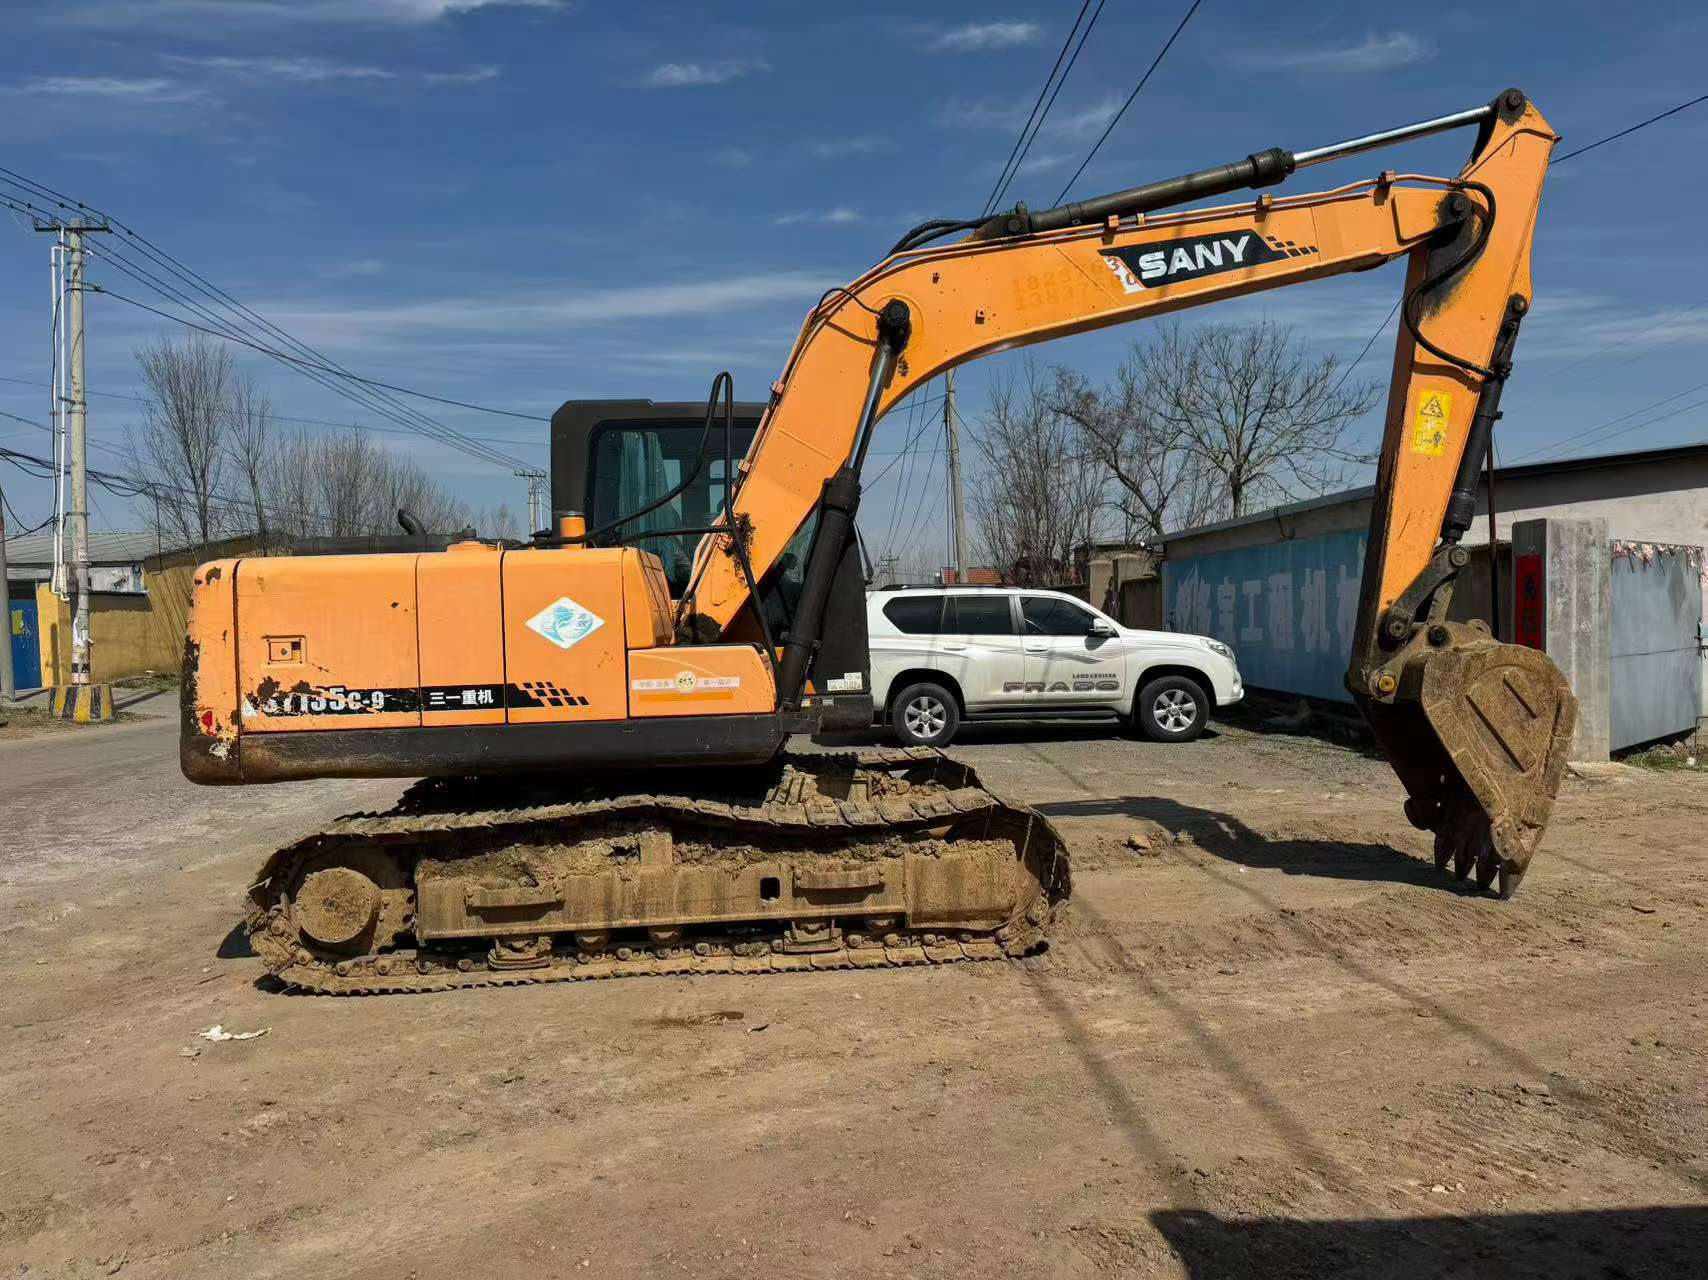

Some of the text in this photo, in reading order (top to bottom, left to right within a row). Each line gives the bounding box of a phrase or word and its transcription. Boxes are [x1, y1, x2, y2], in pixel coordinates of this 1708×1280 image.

[1138, 235, 1250, 280] SANY
[1003, 681, 1120, 693] PRADO
[429, 688, 494, 706] 三一重机
